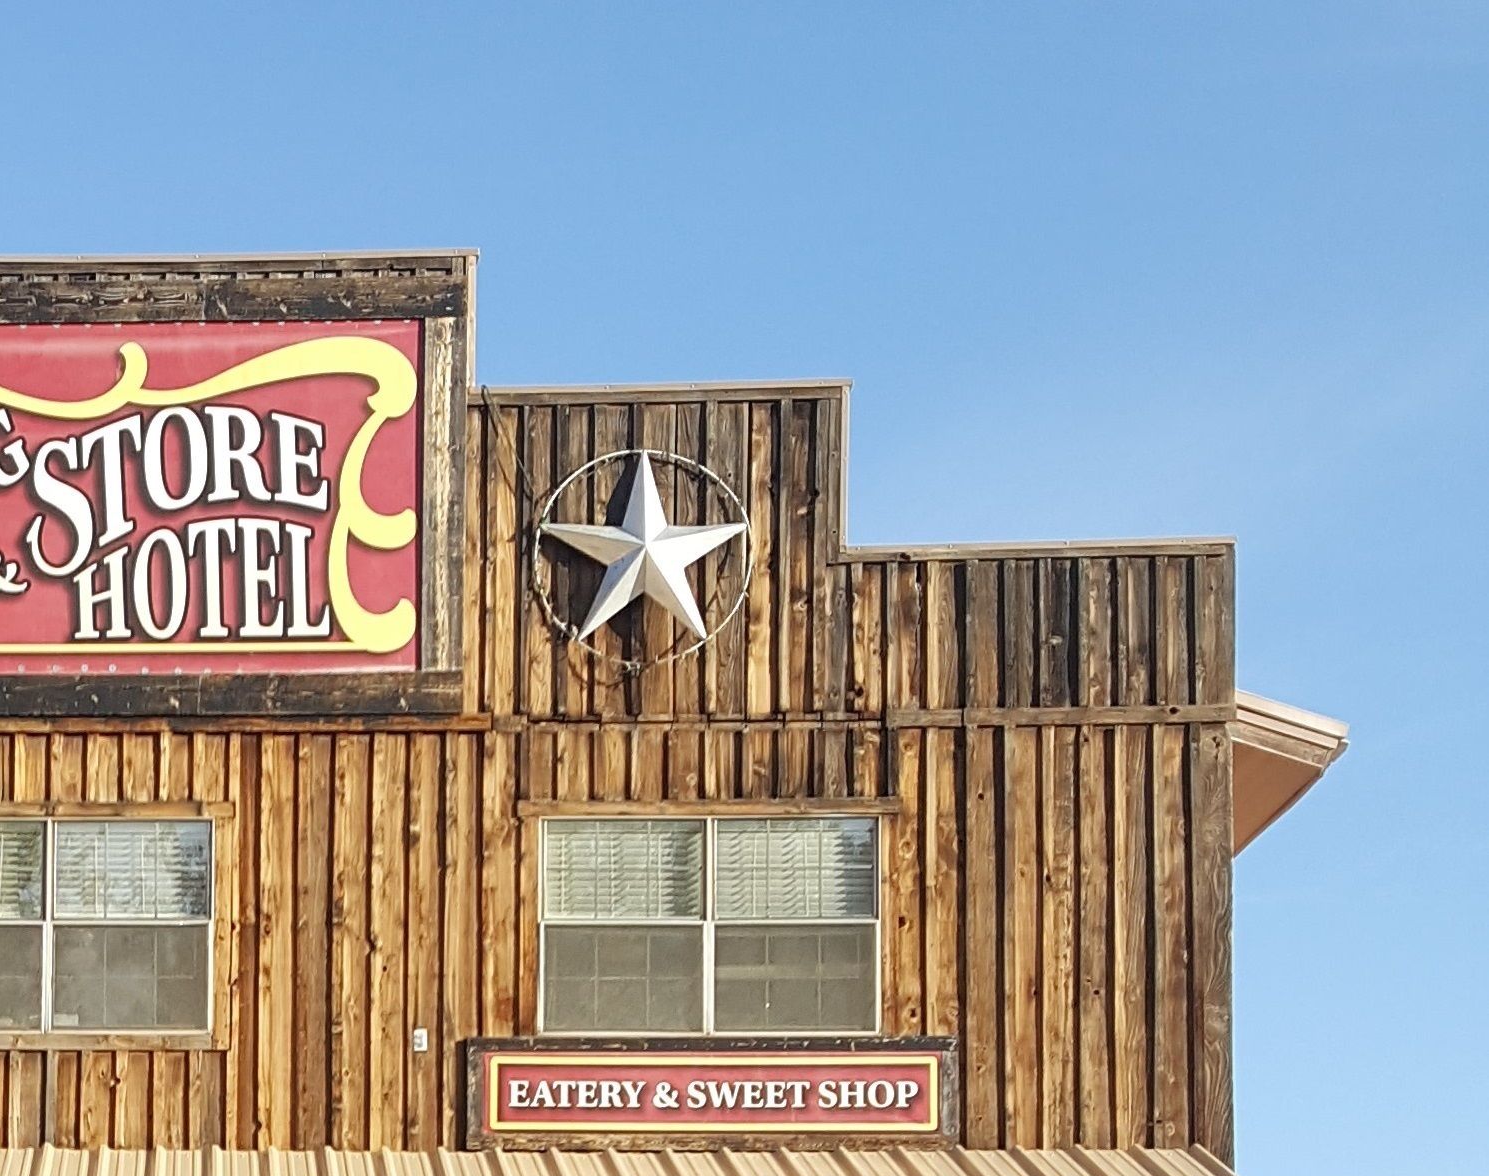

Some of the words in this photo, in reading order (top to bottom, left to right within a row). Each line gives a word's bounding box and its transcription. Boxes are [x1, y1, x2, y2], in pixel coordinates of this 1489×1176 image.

[73, 517, 331, 641] HOTEL
[508, 1079, 647, 1108] EATERY
[652, 1080, 680, 1108] &
[687, 1080, 810, 1109] SWEET
[818, 1080, 919, 1109] SHOP
